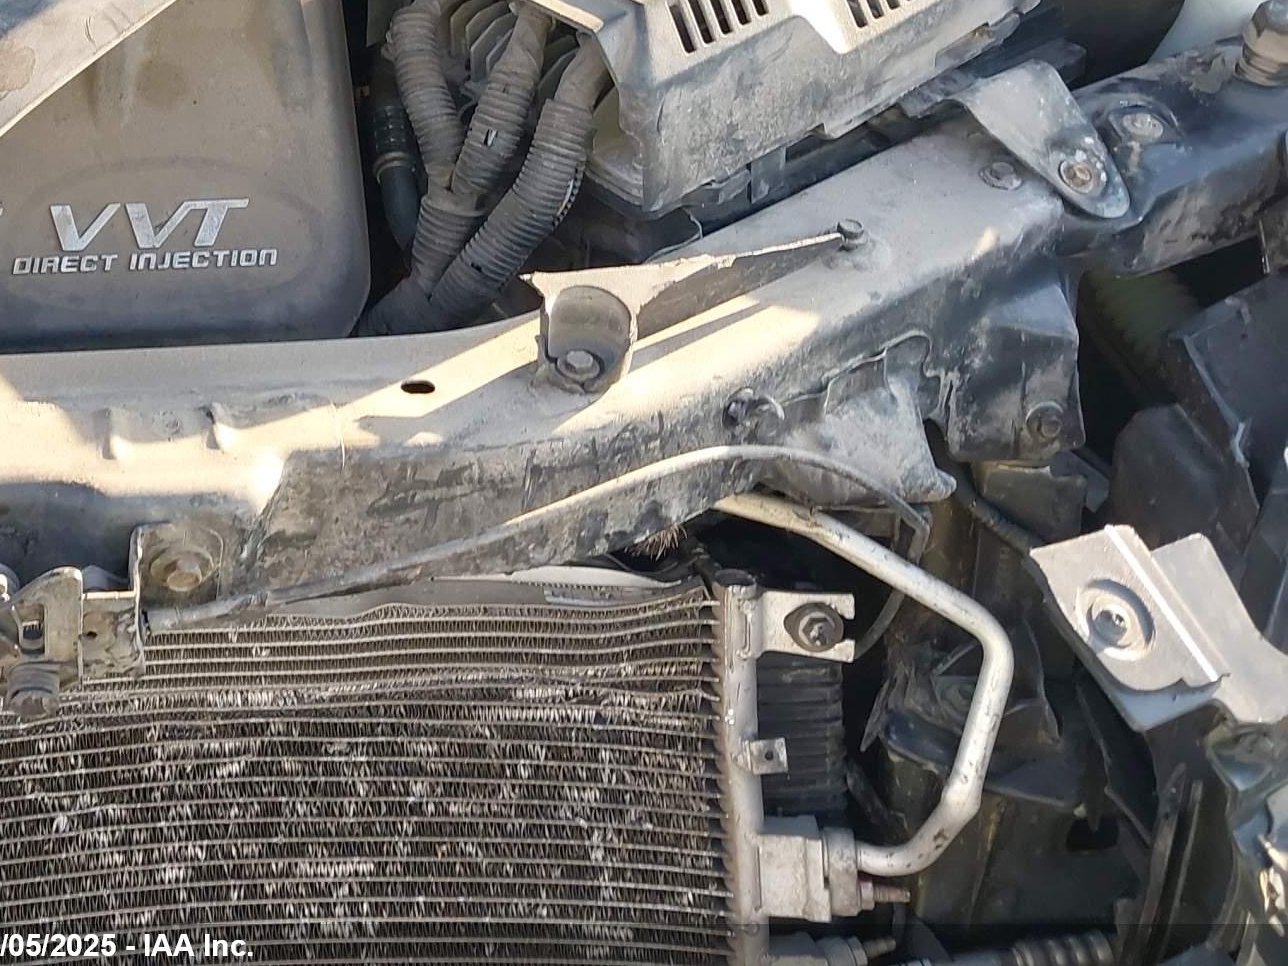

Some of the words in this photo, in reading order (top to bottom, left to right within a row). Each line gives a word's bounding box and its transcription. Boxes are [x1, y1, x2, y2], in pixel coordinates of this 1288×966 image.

[49, 197, 250, 252] VVT
[12, 253, 118, 276] DIRECT
[129, 248, 278, 271] INJECTION
